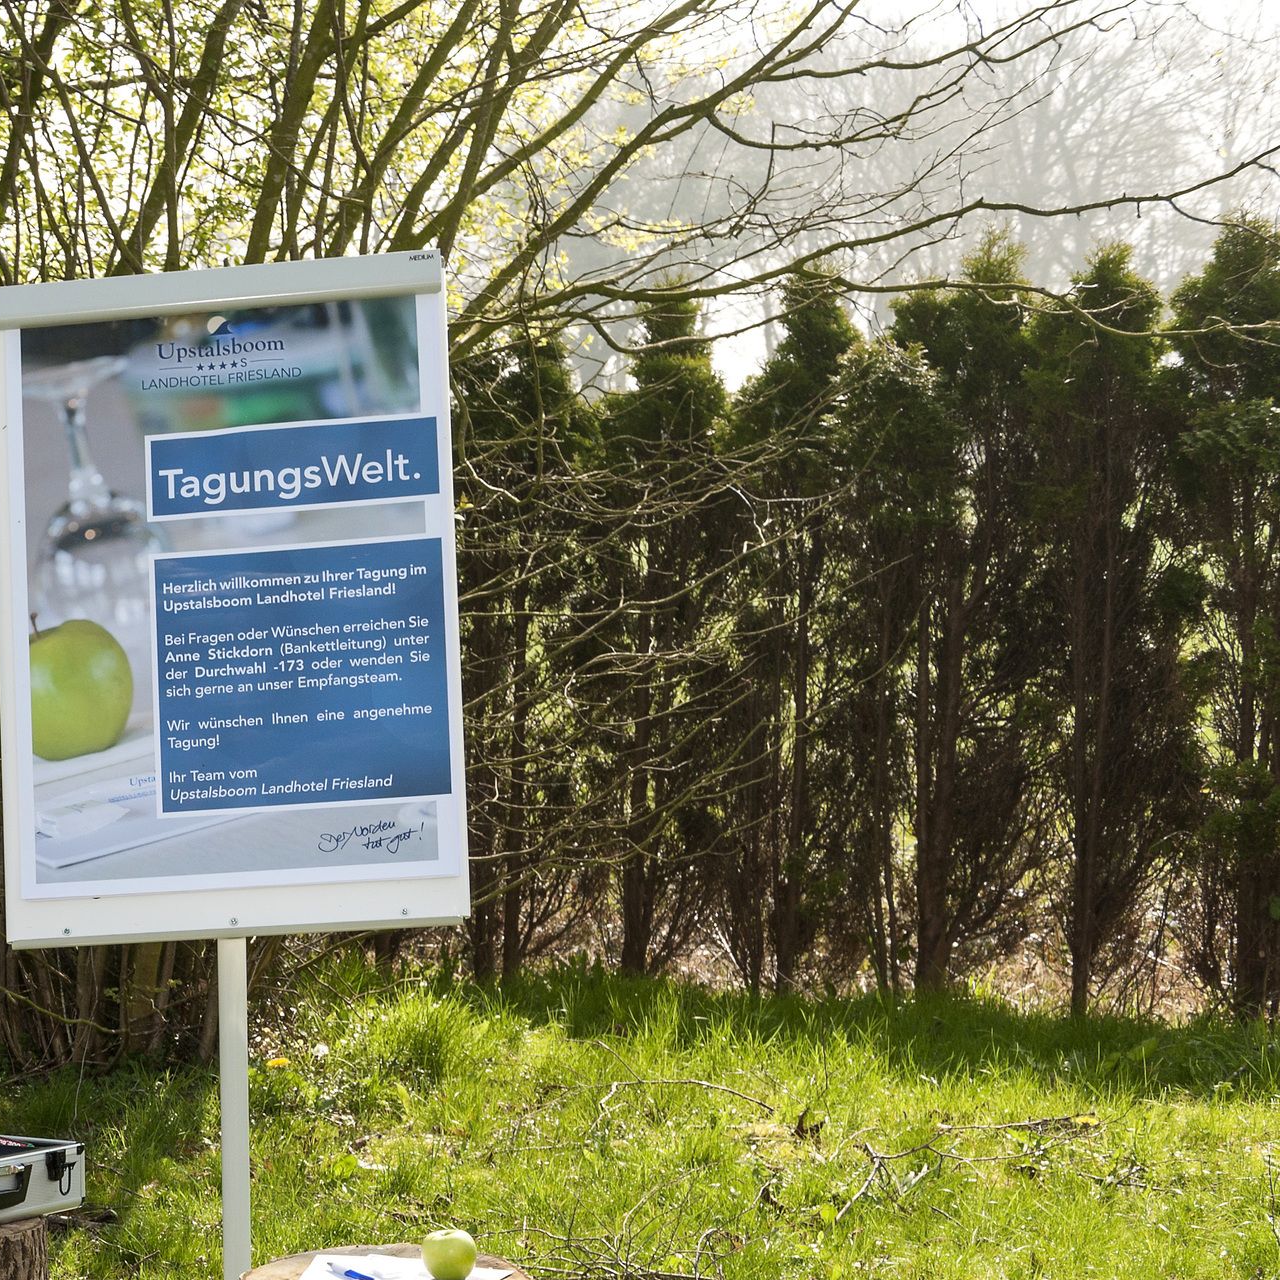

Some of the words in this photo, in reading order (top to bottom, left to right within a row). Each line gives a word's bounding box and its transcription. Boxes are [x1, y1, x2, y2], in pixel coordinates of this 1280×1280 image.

[409, 253, 435, 261] MEDIUM
[156, 337, 285, 363] Upstalsboom
[141, 374, 224, 391] LANDHOTEL
[228, 367, 302, 384] FRIESLAND
[158, 449, 421, 505] TagungsWelt.
[163, 579, 217, 594] Herzlich
[219, 576, 301, 590] willkommen
[304, 574, 320, 584] zu
[322, 570, 354, 583] Ihrer
[356, 567, 407, 581] Tagung
[410, 564, 427, 576] im
[163, 596, 252, 614] Upstalsboom
[256, 588, 325, 605] Landhotel
[329, 582, 396, 599] Friesland!
[164, 633, 185, 646] Bei
[188, 632, 234, 646] Fragen
[237, 628, 269, 641] oder
[270, 623, 340, 638] Wünschen
[343, 618, 406, 633] erreichen
[408, 615, 429, 628] Sie
[164, 651, 200, 663] Anne
[208, 645, 273, 660] Stickdorn
[280, 636, 387, 656] (Bankettleitung)
[393, 635, 430, 647] unter
[165, 668, 188, 680] der
[194, 661, 266, 678] Durchwahl
[273, 659, 305, 672] -173
[311, 657, 343, 670] oder
[349, 652, 403, 667] wenden
[409, 650, 431, 663] Sie
[166, 684, 191, 698] sich
[194, 684, 234, 699] gerne
[237, 682, 253, 693] an
[257, 680, 294, 691] unser
[297, 672, 403, 690] Empfangsteam.
[166, 719, 191, 732] Wir
[197, 714, 263, 730] wünschen
[271, 712, 308, 725] Ihnen
[316, 709, 345, 721] eine
[352, 703, 433, 720] angenehme
[167, 734, 220, 751] Tagung!
[169, 770, 187, 783] Ihr
[189, 769, 225, 782] Team
[228, 769, 258, 779] vom
[170, 786, 257, 804] Upstalsboom
[261, 778, 328, 795] Landhotel
[331, 774, 393, 790] Friesland
[318, 831, 351, 852] Der
[341, 820, 396, 849] Norden
